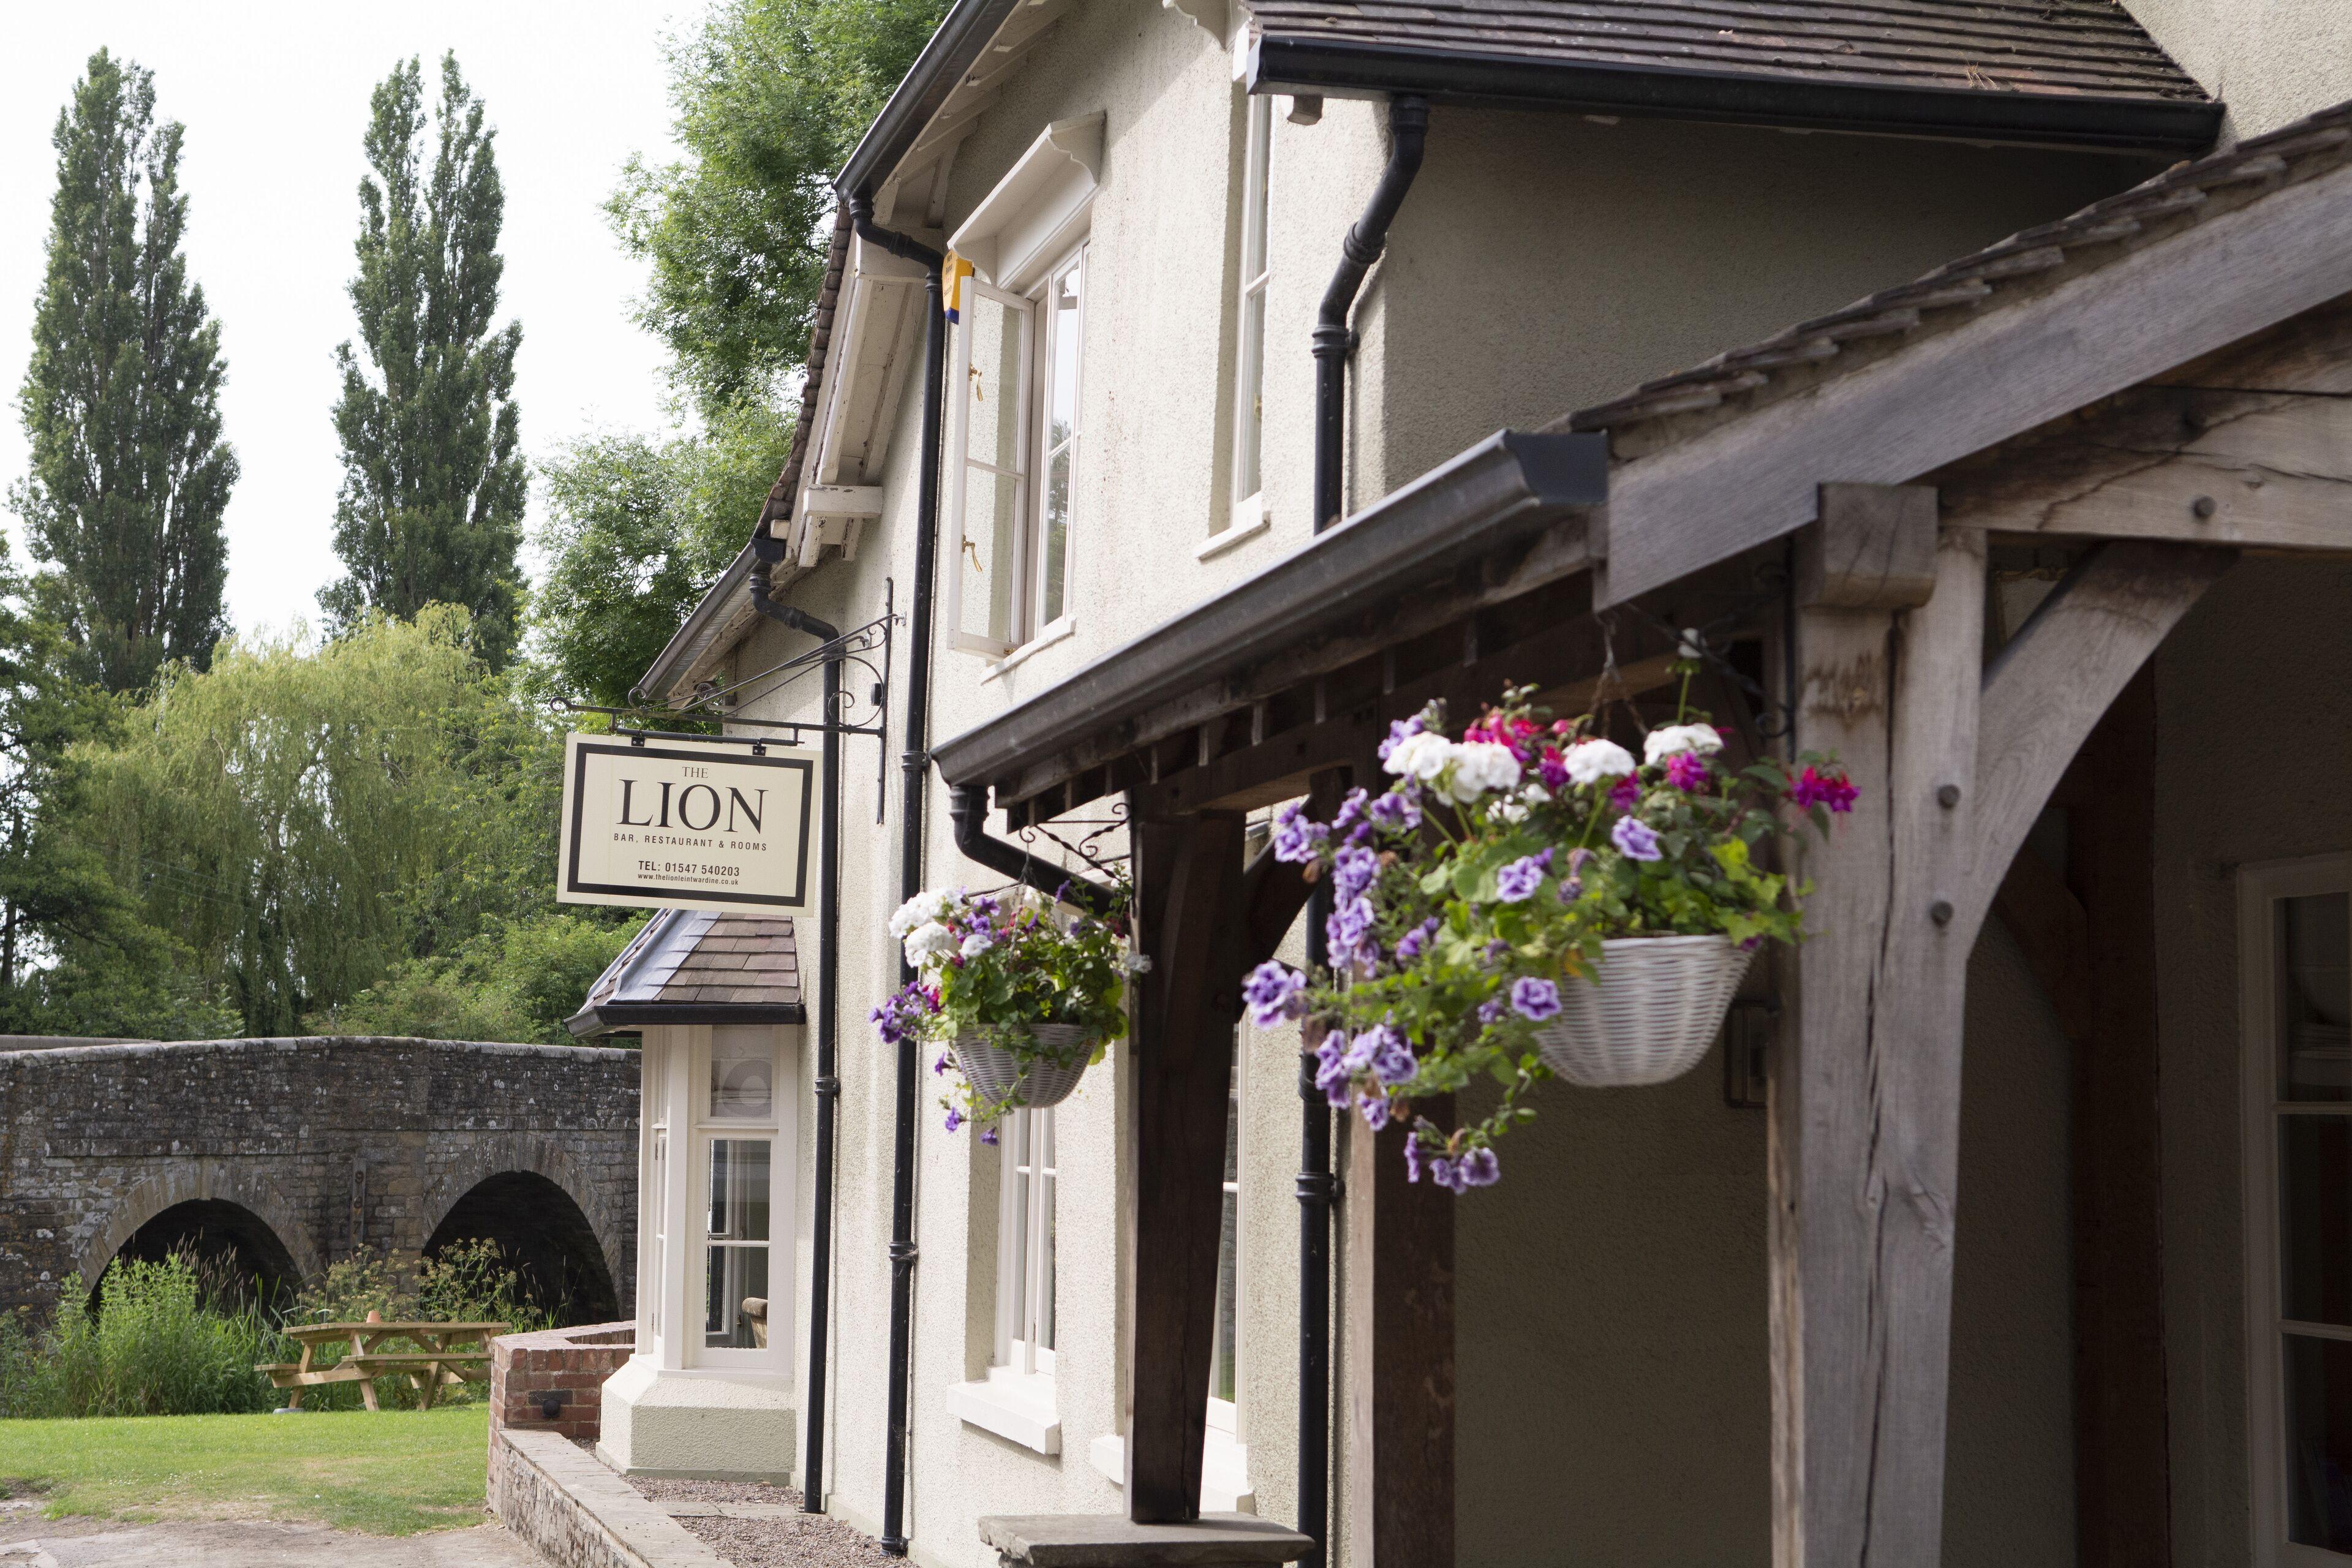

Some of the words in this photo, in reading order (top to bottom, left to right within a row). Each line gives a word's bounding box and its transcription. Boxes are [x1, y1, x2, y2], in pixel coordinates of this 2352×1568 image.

[682, 766, 709, 778] THE
[616, 779, 769, 835] LION
[614, 833, 639, 843] BAR,
[644, 835, 713, 848] RESTAURANT
[718, 840, 725, 849] &
[731, 841, 767, 851] ROOMS
[638, 861, 661, 872] TEL:
[665, 862, 697, 874] 01547
[701, 865, 740, 876] 540203
[638, 873, 739, 886] www.thelionleintwardine.co.uk
[355, 1170, 364, 1184] 9
